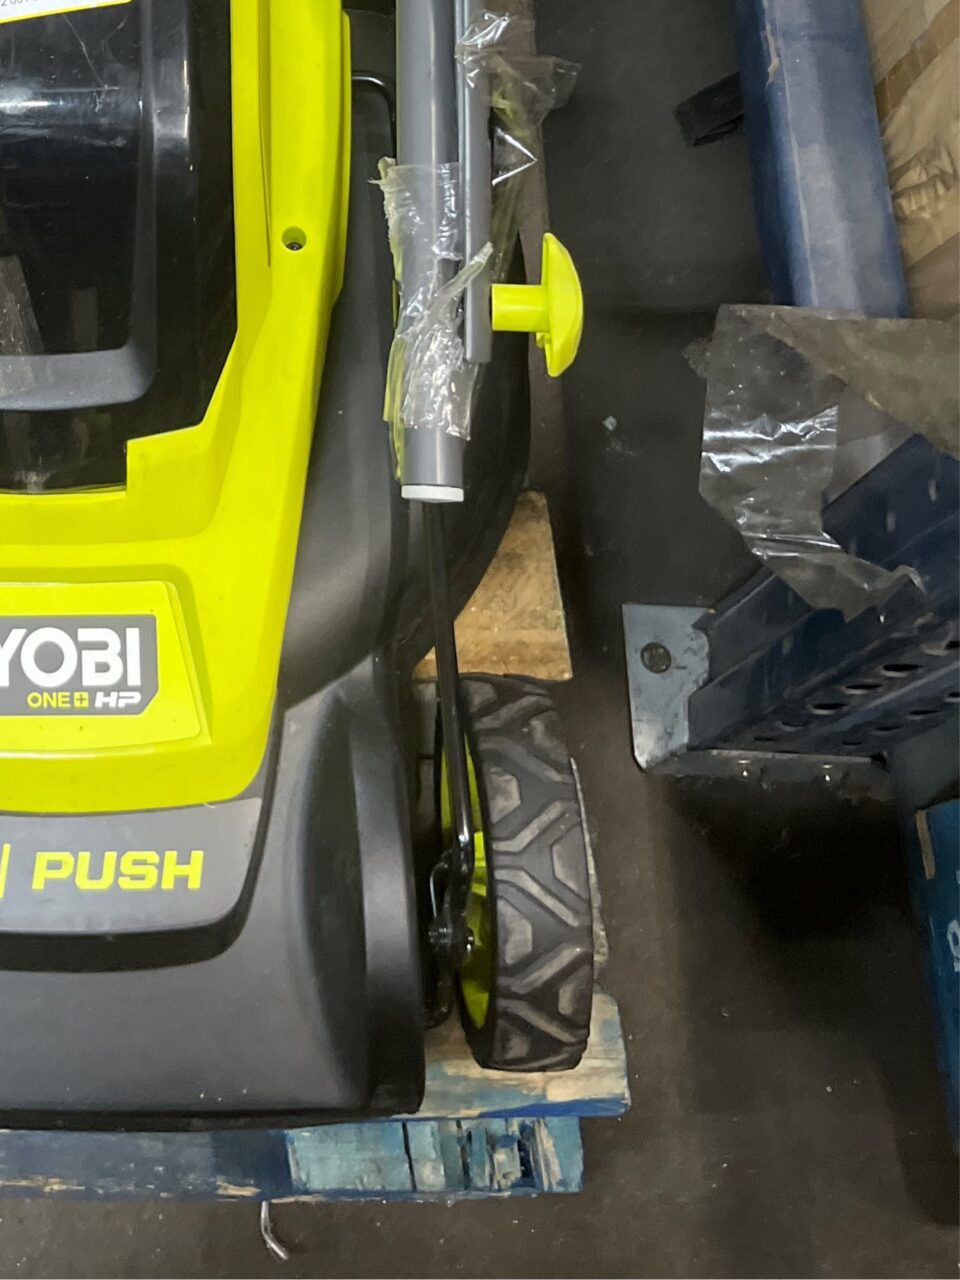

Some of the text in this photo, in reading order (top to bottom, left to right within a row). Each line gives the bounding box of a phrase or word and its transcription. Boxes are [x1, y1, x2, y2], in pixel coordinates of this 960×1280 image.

[27, 691, 142, 709] ONE+ HP
[31, 850, 204, 892] PUSH
